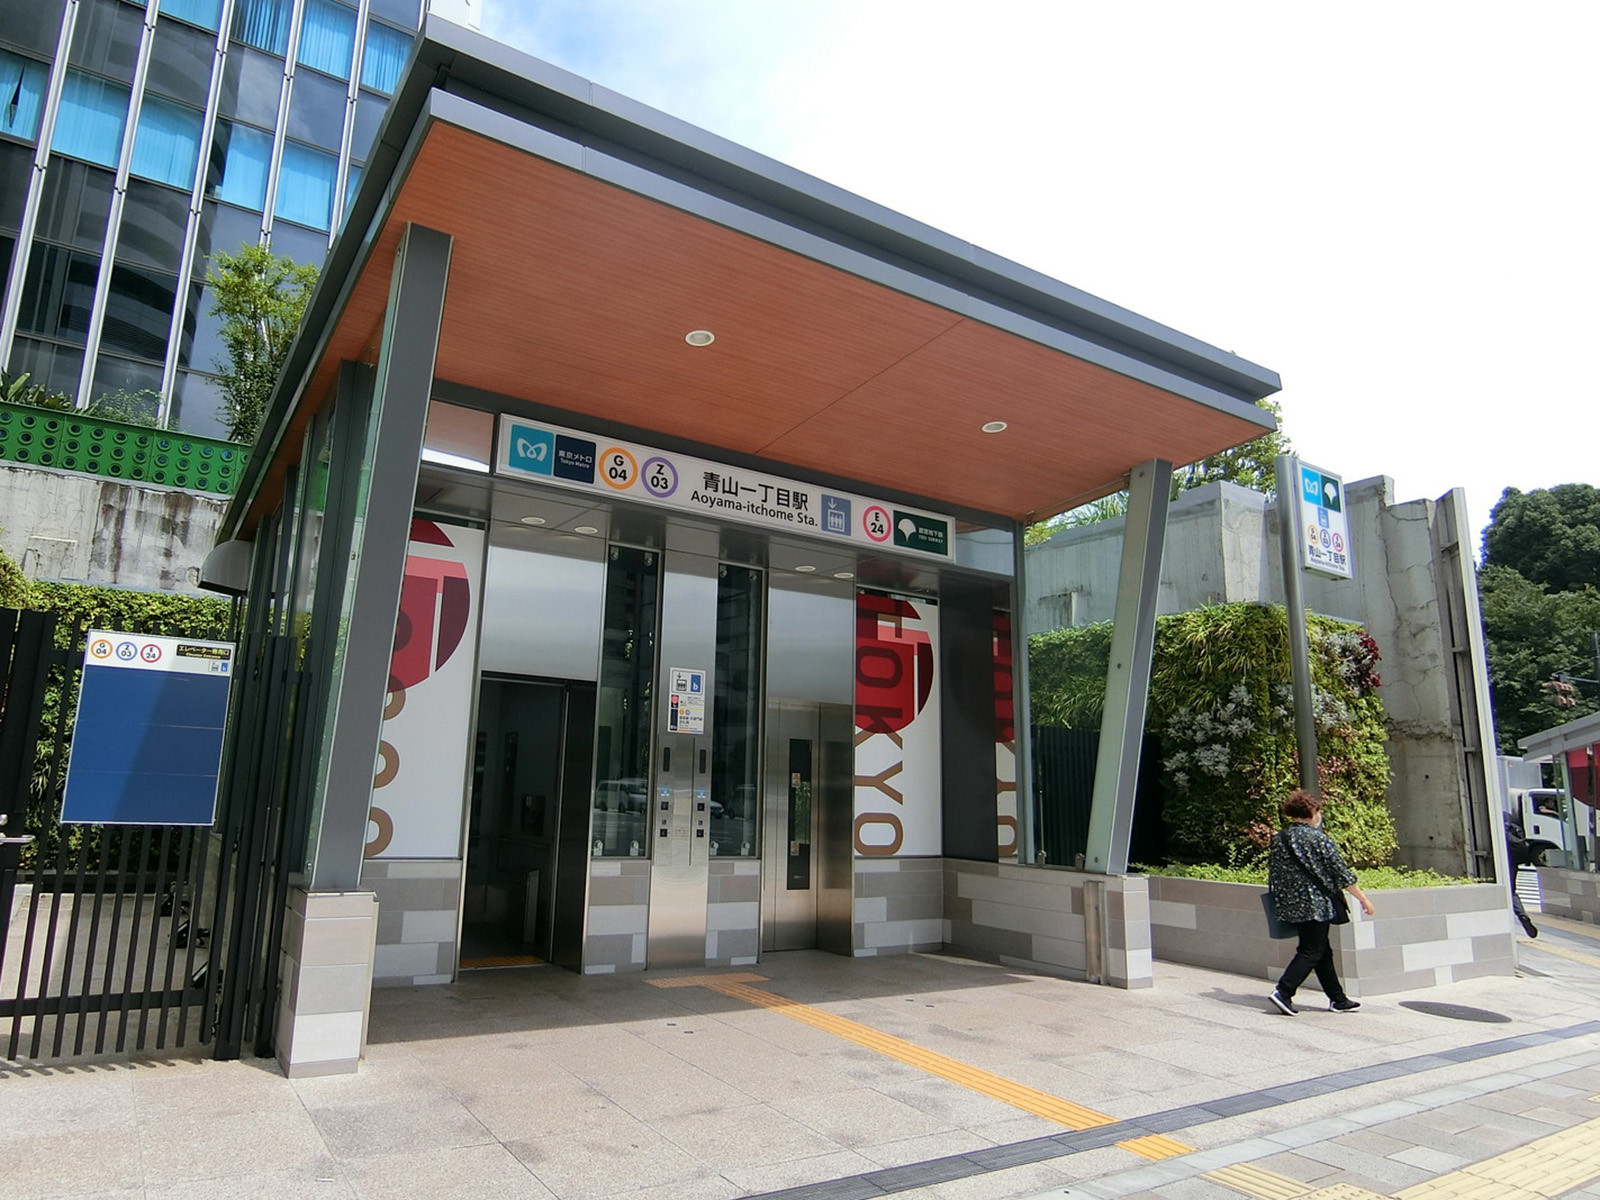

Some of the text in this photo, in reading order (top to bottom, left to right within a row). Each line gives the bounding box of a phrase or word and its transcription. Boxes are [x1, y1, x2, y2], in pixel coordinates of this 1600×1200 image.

[558, 450, 593, 464] 東京メトロ
[560, 458, 590, 469] Tokyo Metro
[613, 455, 624, 467] G
[609, 467, 628, 481] 04
[656, 464, 665, 475] Z
[651, 475, 669, 490] 03
[703, 471, 809, 511] 青山一丁目駅
[690, 490, 818, 527] Aoyama-itchome Sta.
[875, 512, 880, 522] E
[870, 522, 885, 535] 24
[1308, 544, 1346, 565] 青山一丁目駅
